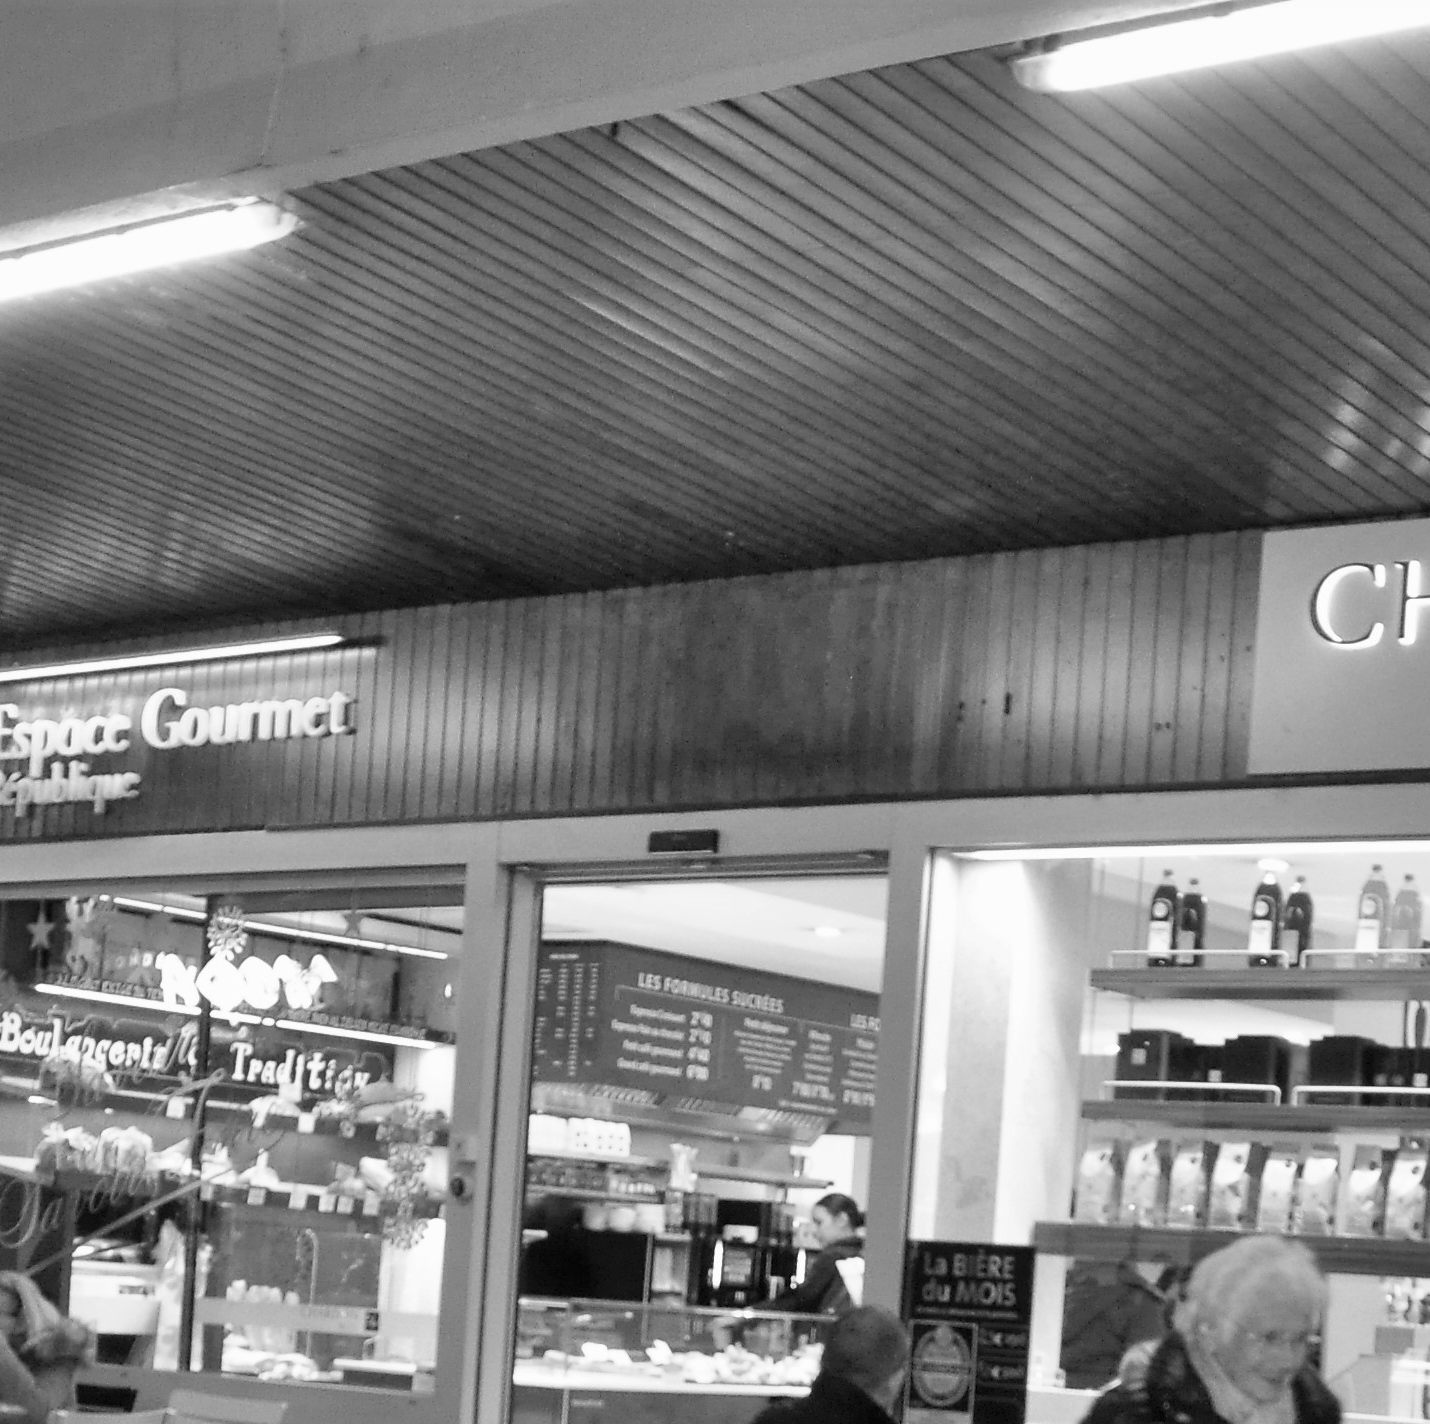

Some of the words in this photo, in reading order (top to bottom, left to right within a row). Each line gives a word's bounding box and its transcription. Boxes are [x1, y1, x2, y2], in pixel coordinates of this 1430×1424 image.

[141, 687, 356, 750] Gourmet
[637, 972, 662, 991] LES
[664, 976, 730, 1004] FORMULES
[952, 1248, 1016, 1281] BIÈRE
[922, 1276, 952, 1303] du
[954, 1280, 1017, 1307] MOIS
